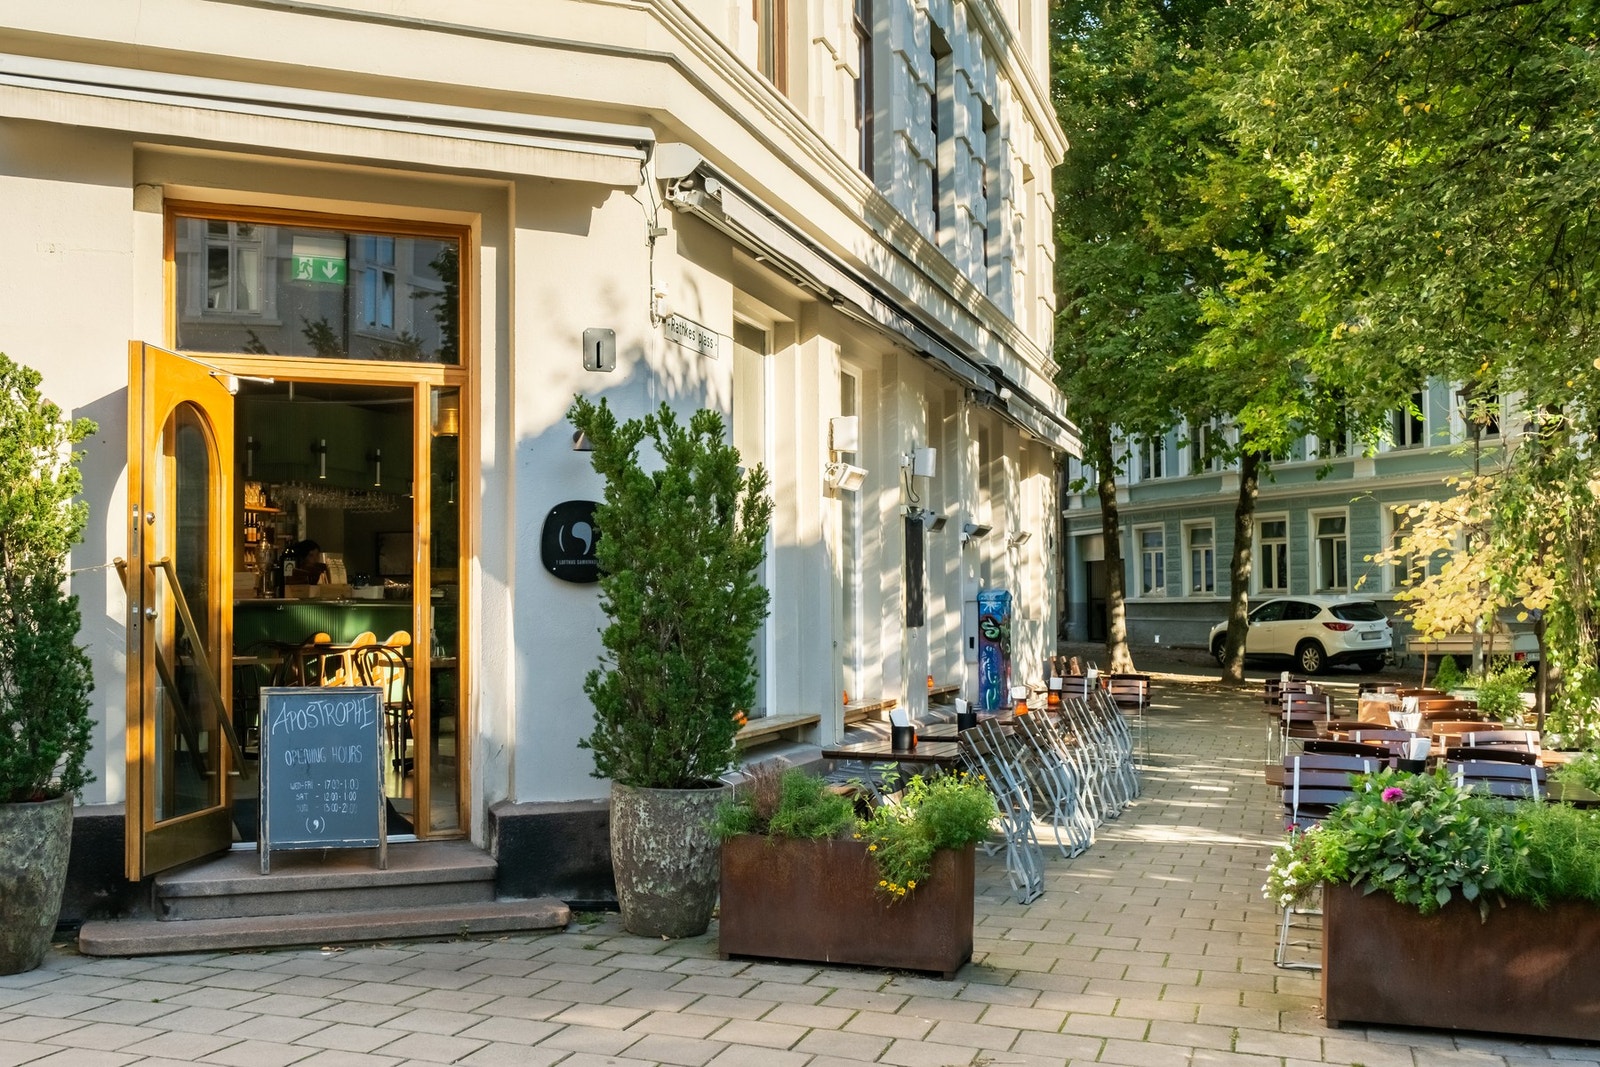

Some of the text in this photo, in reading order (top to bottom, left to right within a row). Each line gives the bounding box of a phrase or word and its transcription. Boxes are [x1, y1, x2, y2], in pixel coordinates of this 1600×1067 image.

[670, 317, 714, 349] Rathkes plass
[272, 694, 375, 736] APOSTROPHE
[284, 745, 363, 766] OPENING HOURS
[295, 792, 309, 801] SAT
